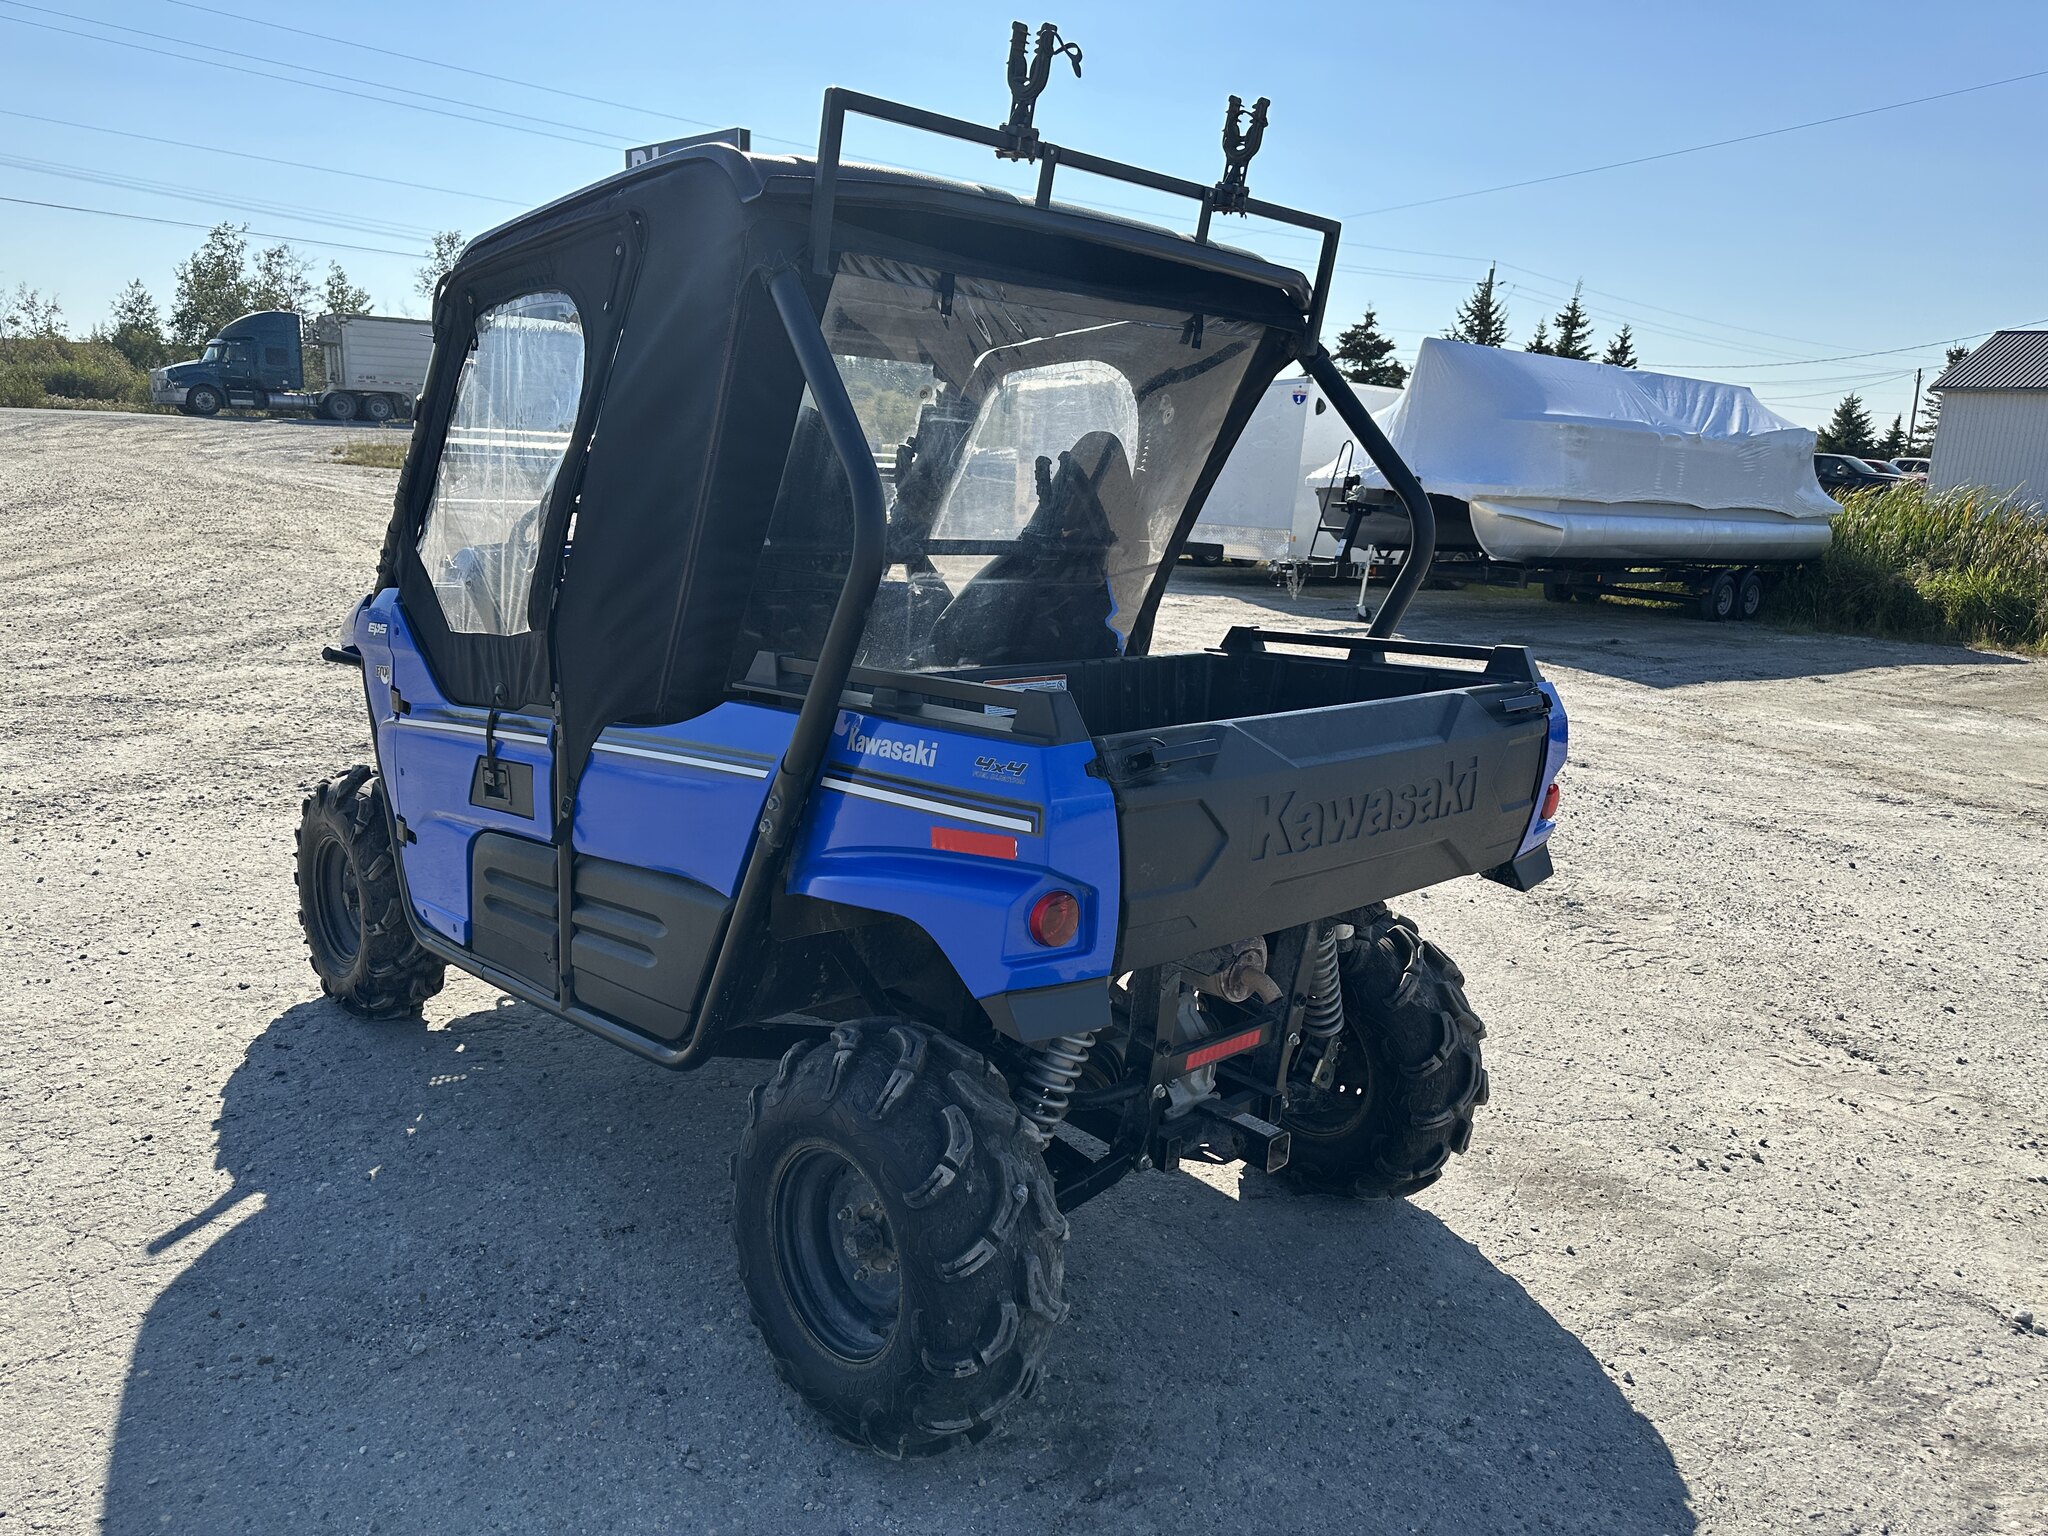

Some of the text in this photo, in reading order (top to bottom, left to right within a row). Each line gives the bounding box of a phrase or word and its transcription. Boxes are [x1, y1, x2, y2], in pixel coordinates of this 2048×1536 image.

[368, 622, 387, 635] EPS
[846, 727, 939, 767] Kawasaki
[975, 756, 1028, 776] 4x4
[1250, 756, 1479, 861] Kawasaki
